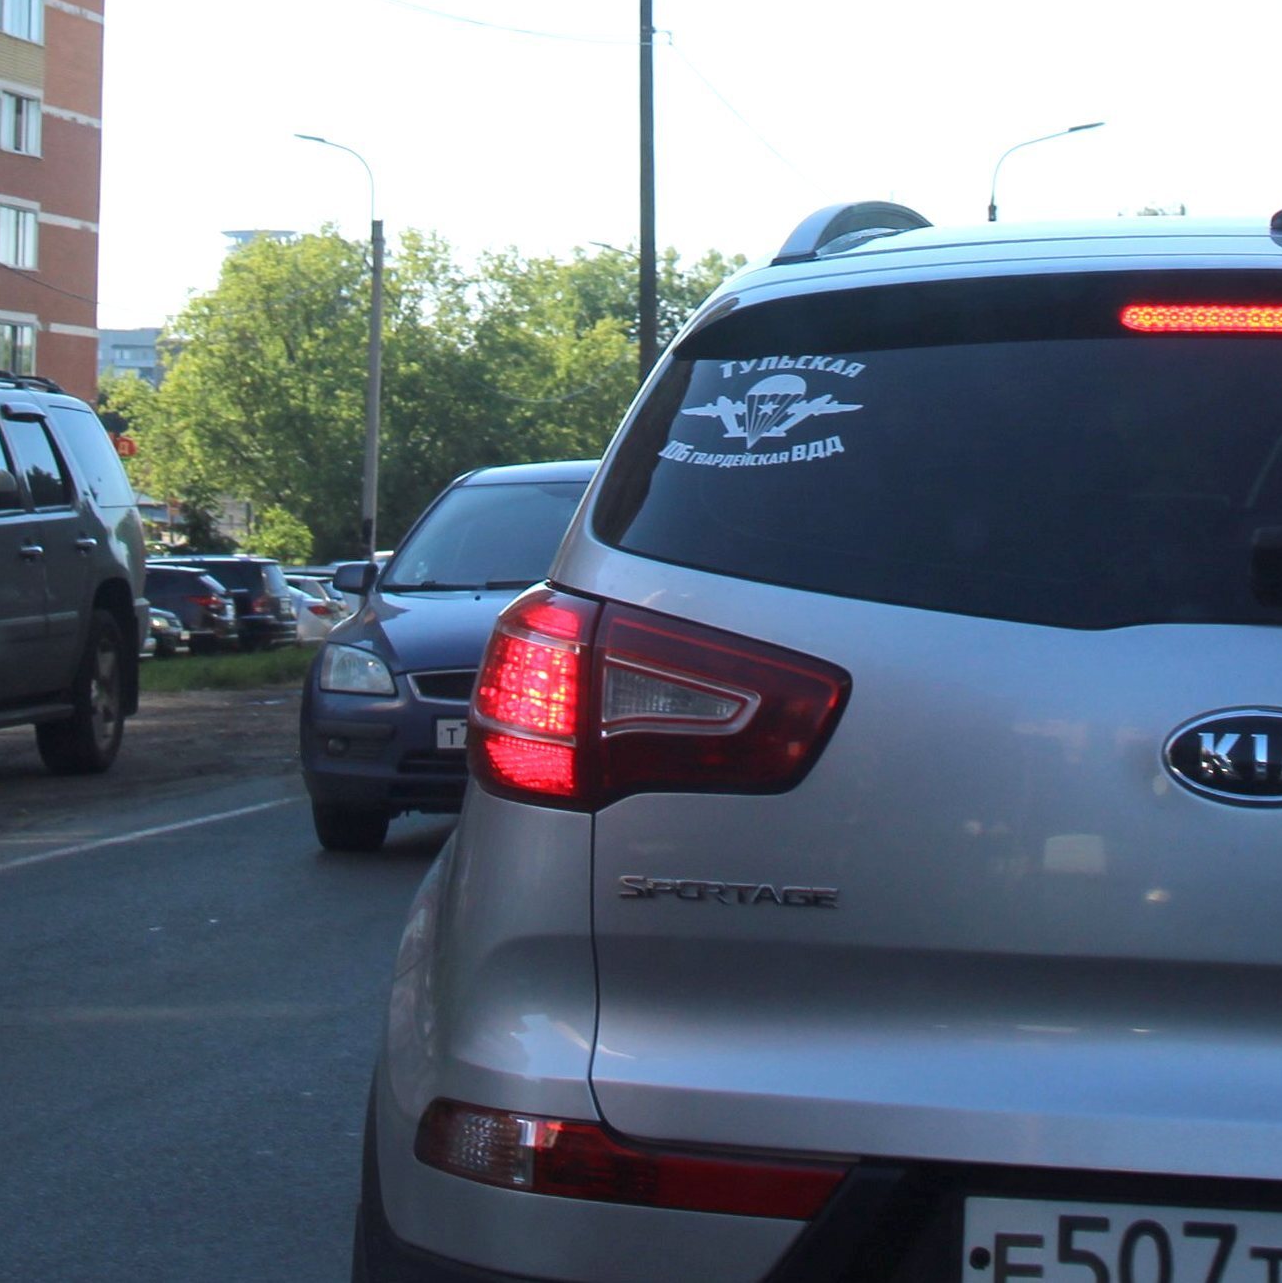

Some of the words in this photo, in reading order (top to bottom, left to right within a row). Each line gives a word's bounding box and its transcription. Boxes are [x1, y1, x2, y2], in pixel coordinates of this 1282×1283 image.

[720, 355, 866, 378] ТУЛЬСКАЯ
[658, 439, 694, 464] 106
[687, 450, 791, 469] ГВАРДЕЙСКАЯ
[791, 435, 846, 462] ВДД
[618, 874, 840, 910] SPORTAGE
